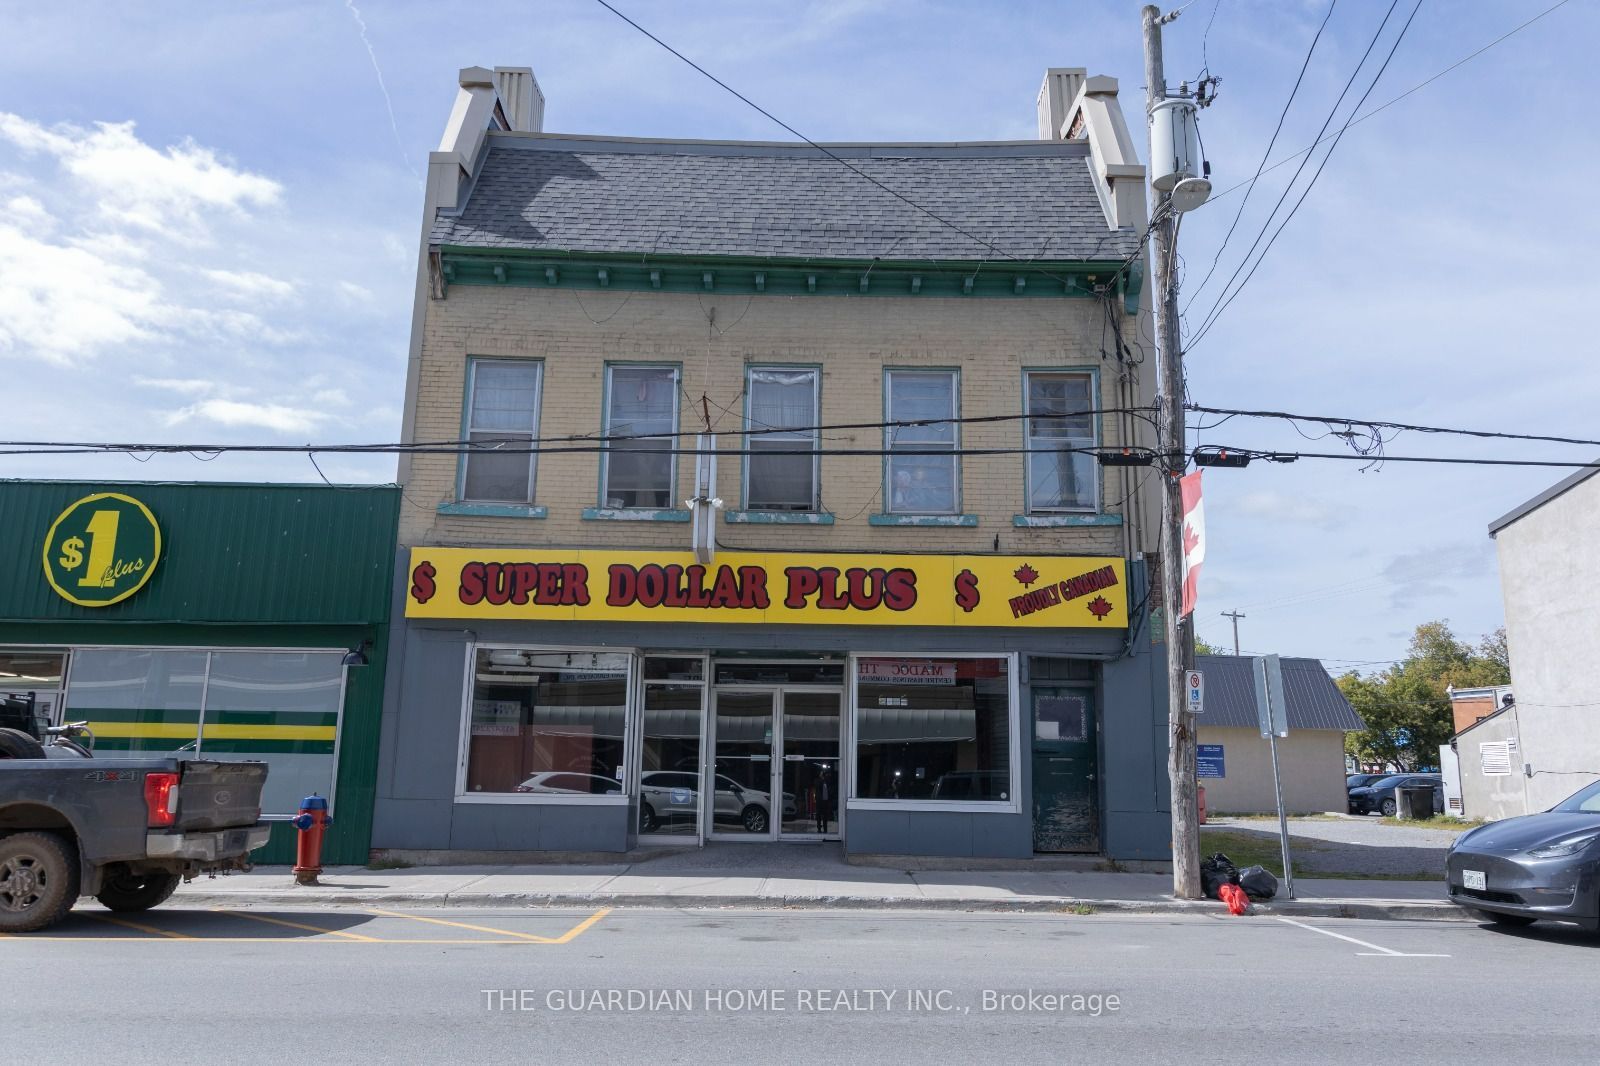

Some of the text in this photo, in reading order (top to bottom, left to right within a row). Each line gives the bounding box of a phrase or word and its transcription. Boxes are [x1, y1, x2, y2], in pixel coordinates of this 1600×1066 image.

[101, 558, 145, 589] plus
[411, 560, 981, 613] $ SUPER DOLLAR PLUS $
[1008, 565, 1119, 619] PROUDLY CANADIAN
